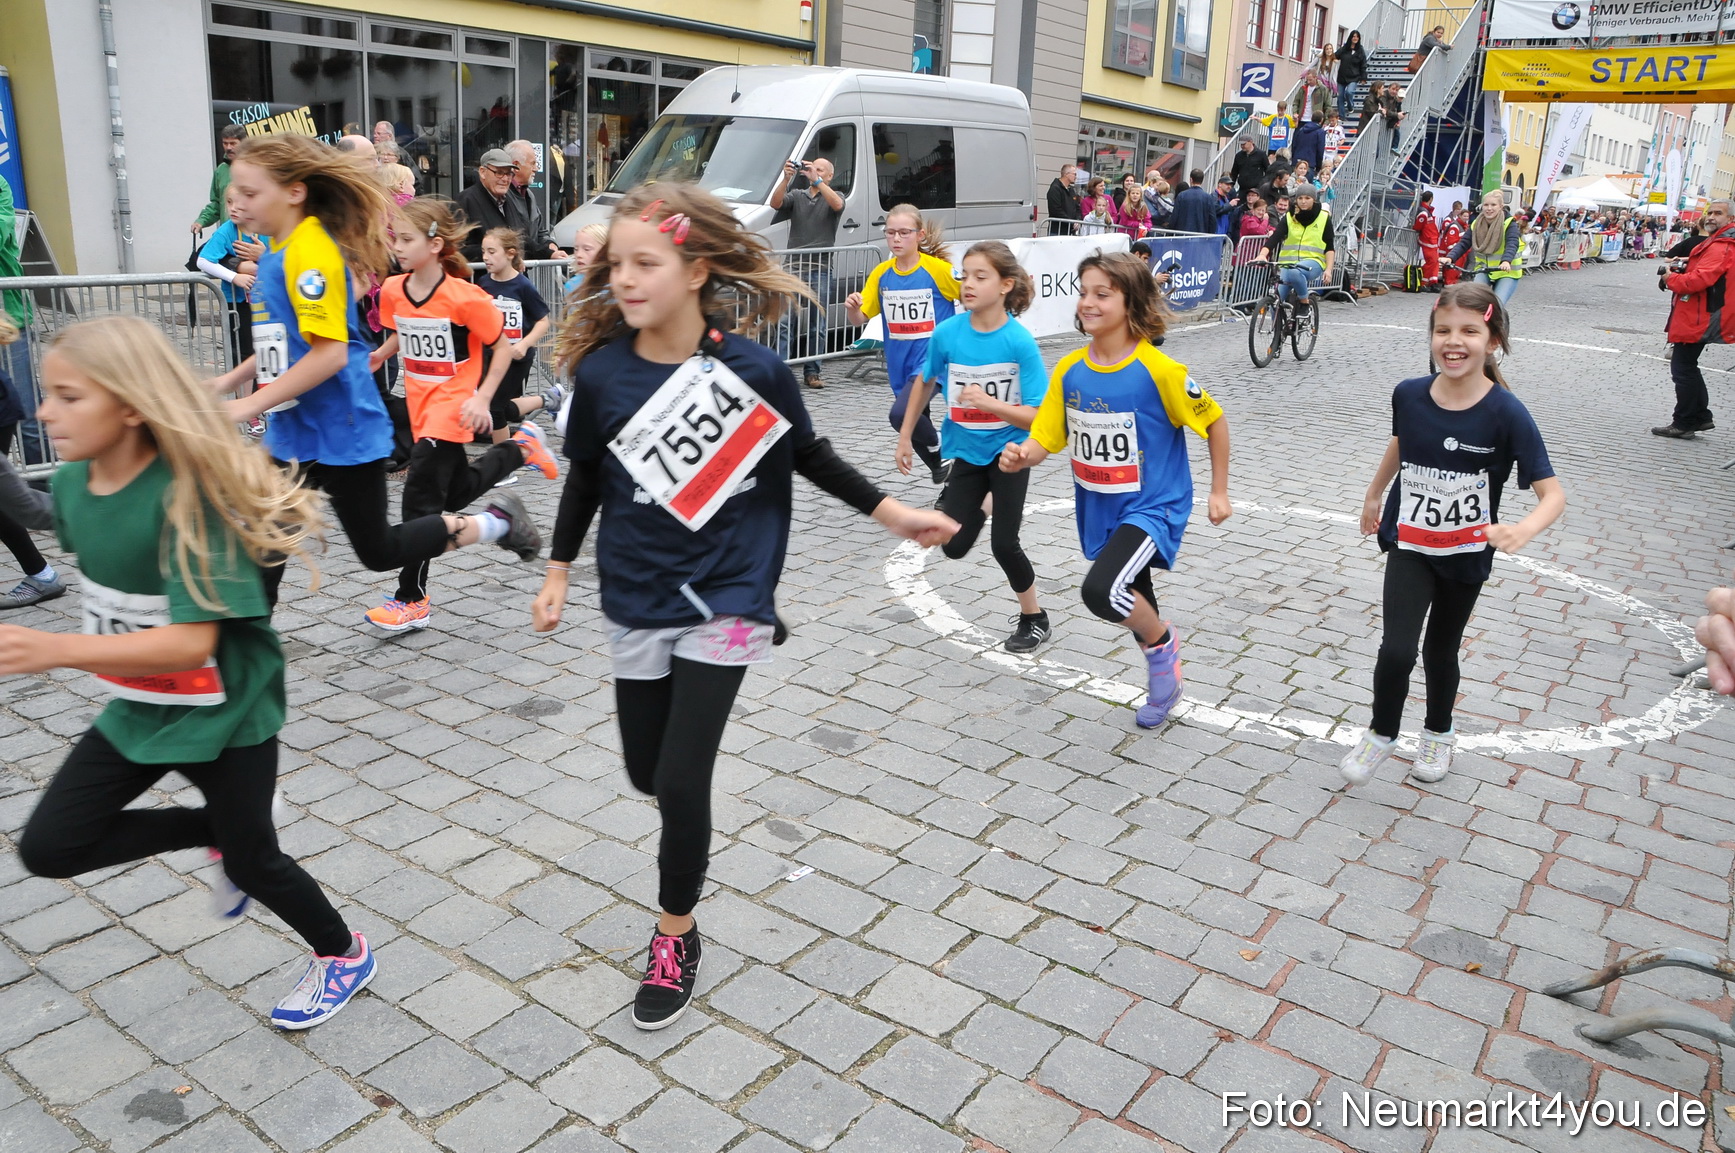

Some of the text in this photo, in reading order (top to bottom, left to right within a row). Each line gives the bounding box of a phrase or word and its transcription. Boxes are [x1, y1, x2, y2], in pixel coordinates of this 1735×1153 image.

[1587, 18, 1628, 29] Weniger
[1629, 15, 1684, 26] Verbrauch.
[1687, 12, 1715, 23] Mehr
[1588, 3, 1630, 16] BMW
[1590, 54, 1718, 83] START
[229, 102, 270, 126] SEASON
[1558, 136, 1571, 158] BKK
[1547, 159, 1561, 185] Audi
[1041, 271, 1081, 298] BKK
[888, 301, 929, 321] 7167
[900, 324, 920, 333] Meike
[401, 332, 447, 359] 7039
[650, 373, 704, 429] Neumarkt
[955, 378, 1012, 402] 797
[640, 381, 746, 486] 7554
[1081, 420, 1120, 430] Neumarkt
[1073, 430, 1130, 462] 7049
[1084, 467, 1112, 482] Stella
[1402, 478, 1473, 497] PARTL Neumarkt
[1409, 492, 1482, 528] 7543
